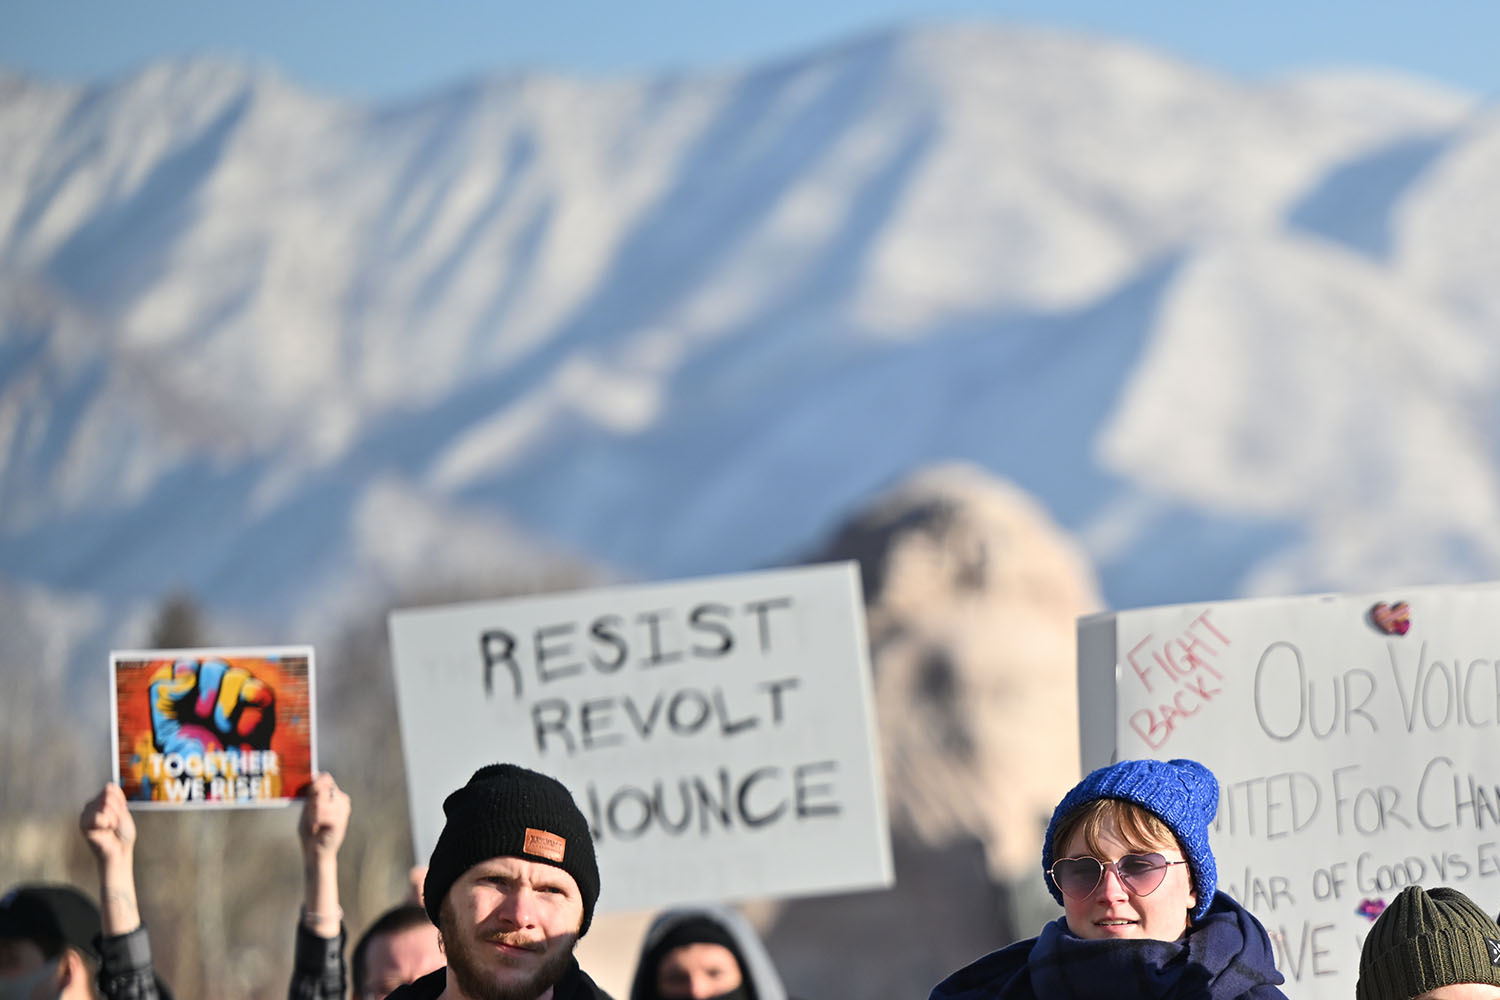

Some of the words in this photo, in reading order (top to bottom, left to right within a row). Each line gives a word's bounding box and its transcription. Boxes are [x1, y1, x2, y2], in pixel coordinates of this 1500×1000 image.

[479, 598, 796, 700] RESIST
[1127, 608, 1232, 694] FIGHT
[531, 678, 800, 756] REVOLT
[1254, 640, 1381, 741] OUR
[150, 750, 280, 777] TOGETHER
[164, 777, 206, 801] WE
[210, 776, 272, 801] RISE!
[1213, 770, 1323, 840] ITED
[1332, 764, 1412, 838] FOR
[1312, 861, 1348, 902] OF
[1356, 845, 1427, 895] GOOD
